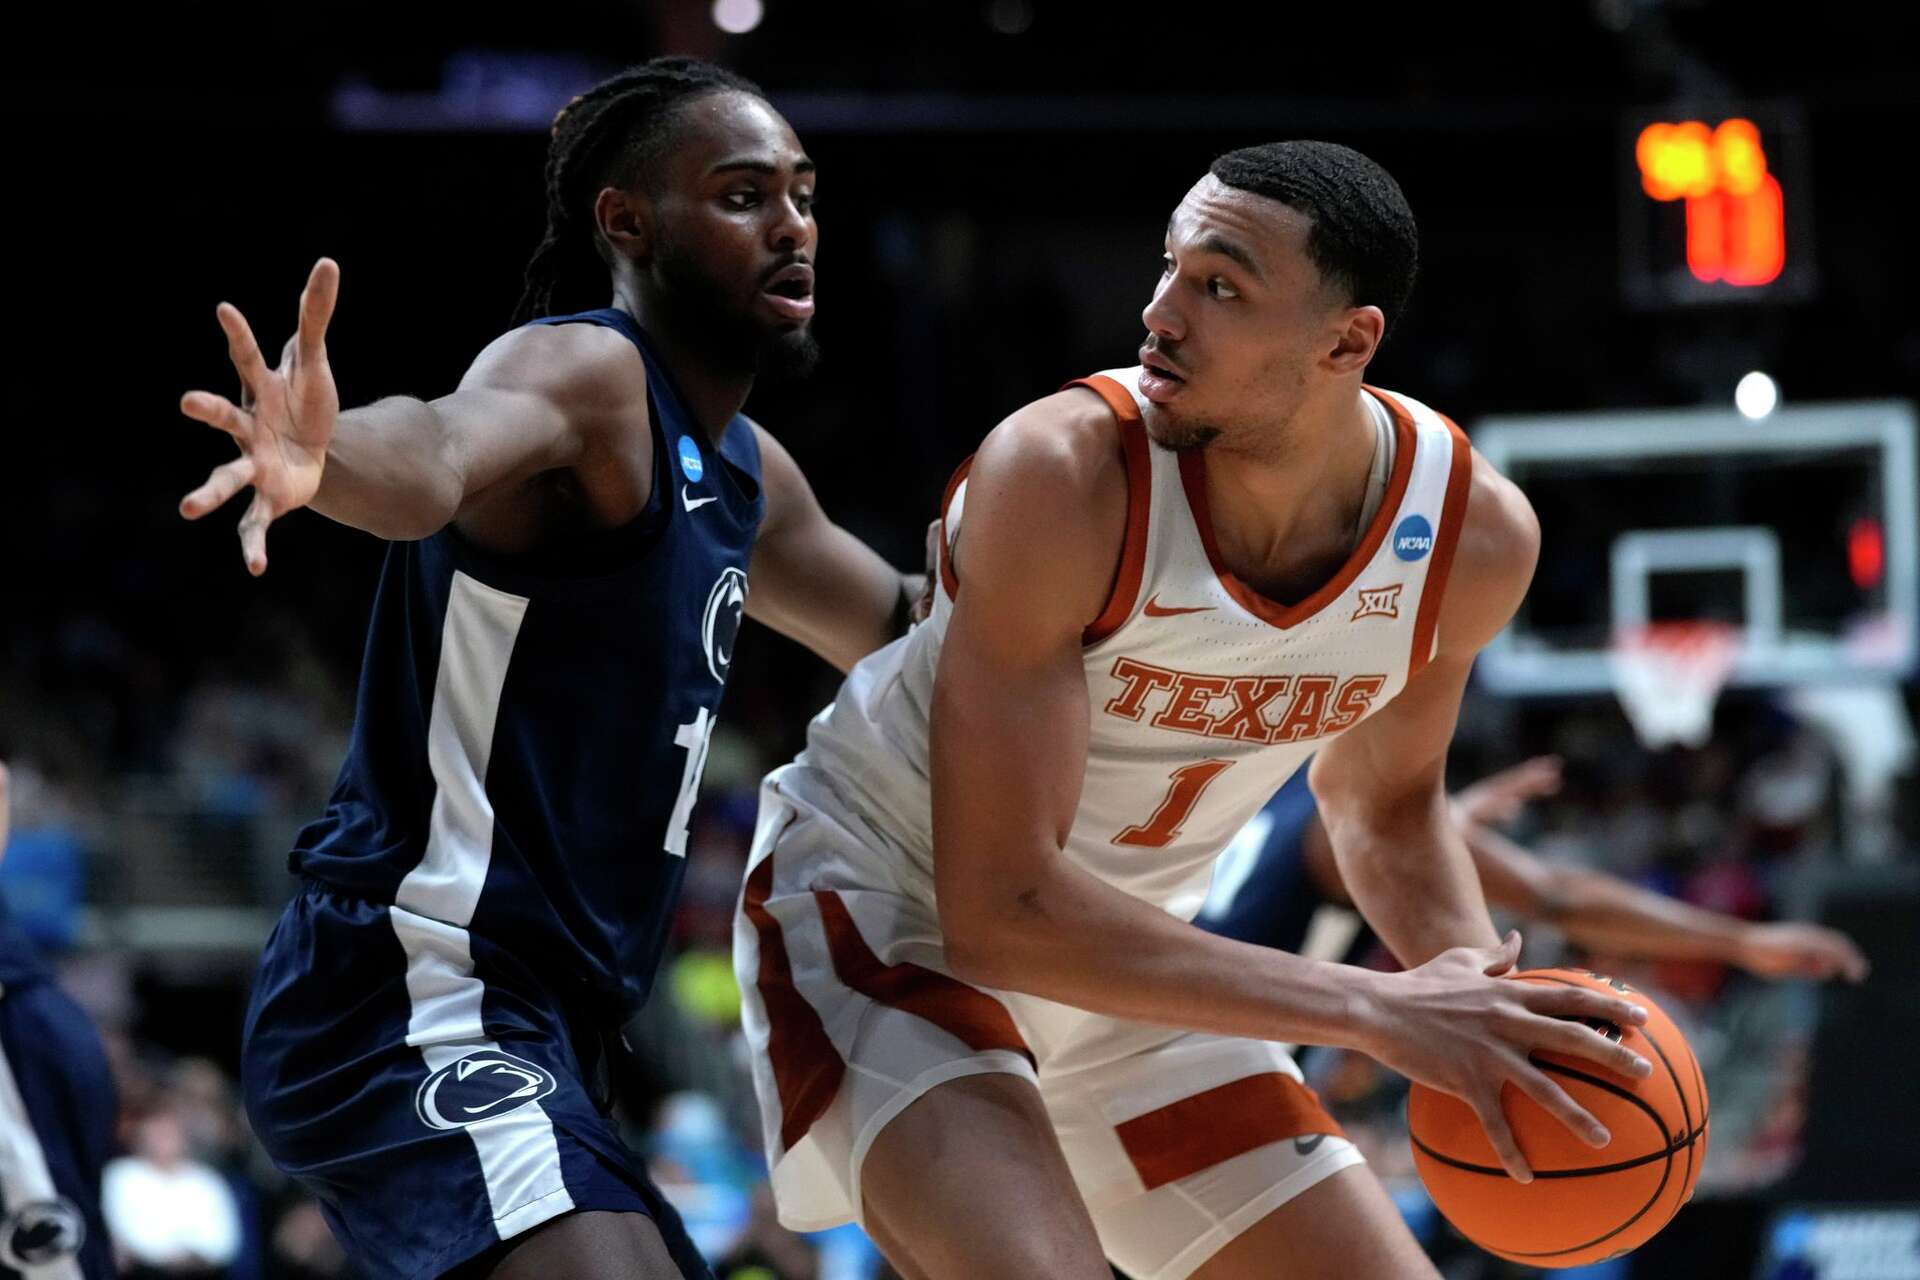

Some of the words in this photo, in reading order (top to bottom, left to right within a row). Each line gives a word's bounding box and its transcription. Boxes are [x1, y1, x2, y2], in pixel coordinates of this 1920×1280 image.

[1398, 537, 1430, 550] NCAA
[1104, 657, 1387, 744] TEXAS
[1111, 759, 1236, 848] 1
